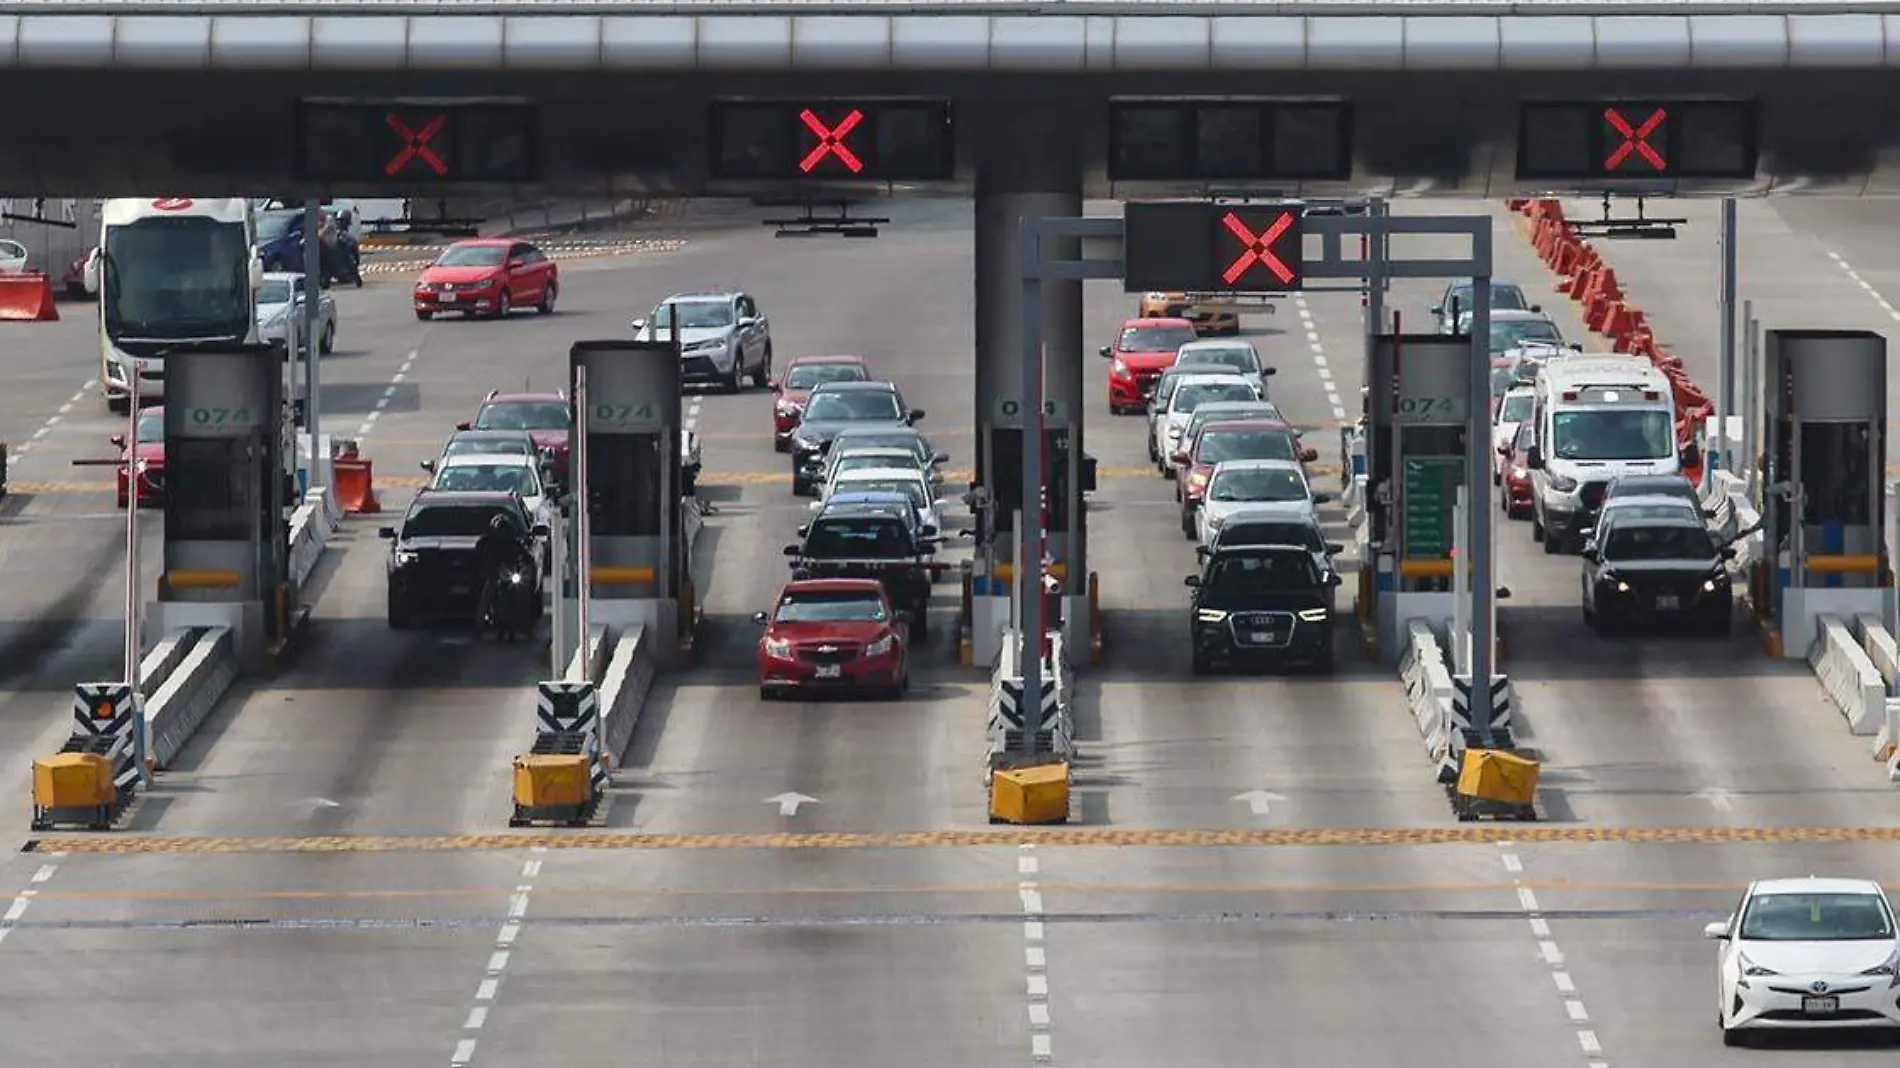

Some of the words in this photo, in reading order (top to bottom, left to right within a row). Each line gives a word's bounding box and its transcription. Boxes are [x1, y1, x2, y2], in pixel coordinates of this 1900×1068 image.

[597, 404, 653, 420] 074
[1002, 401, 1055, 416] 04
[1401, 397, 1453, 413] 074
